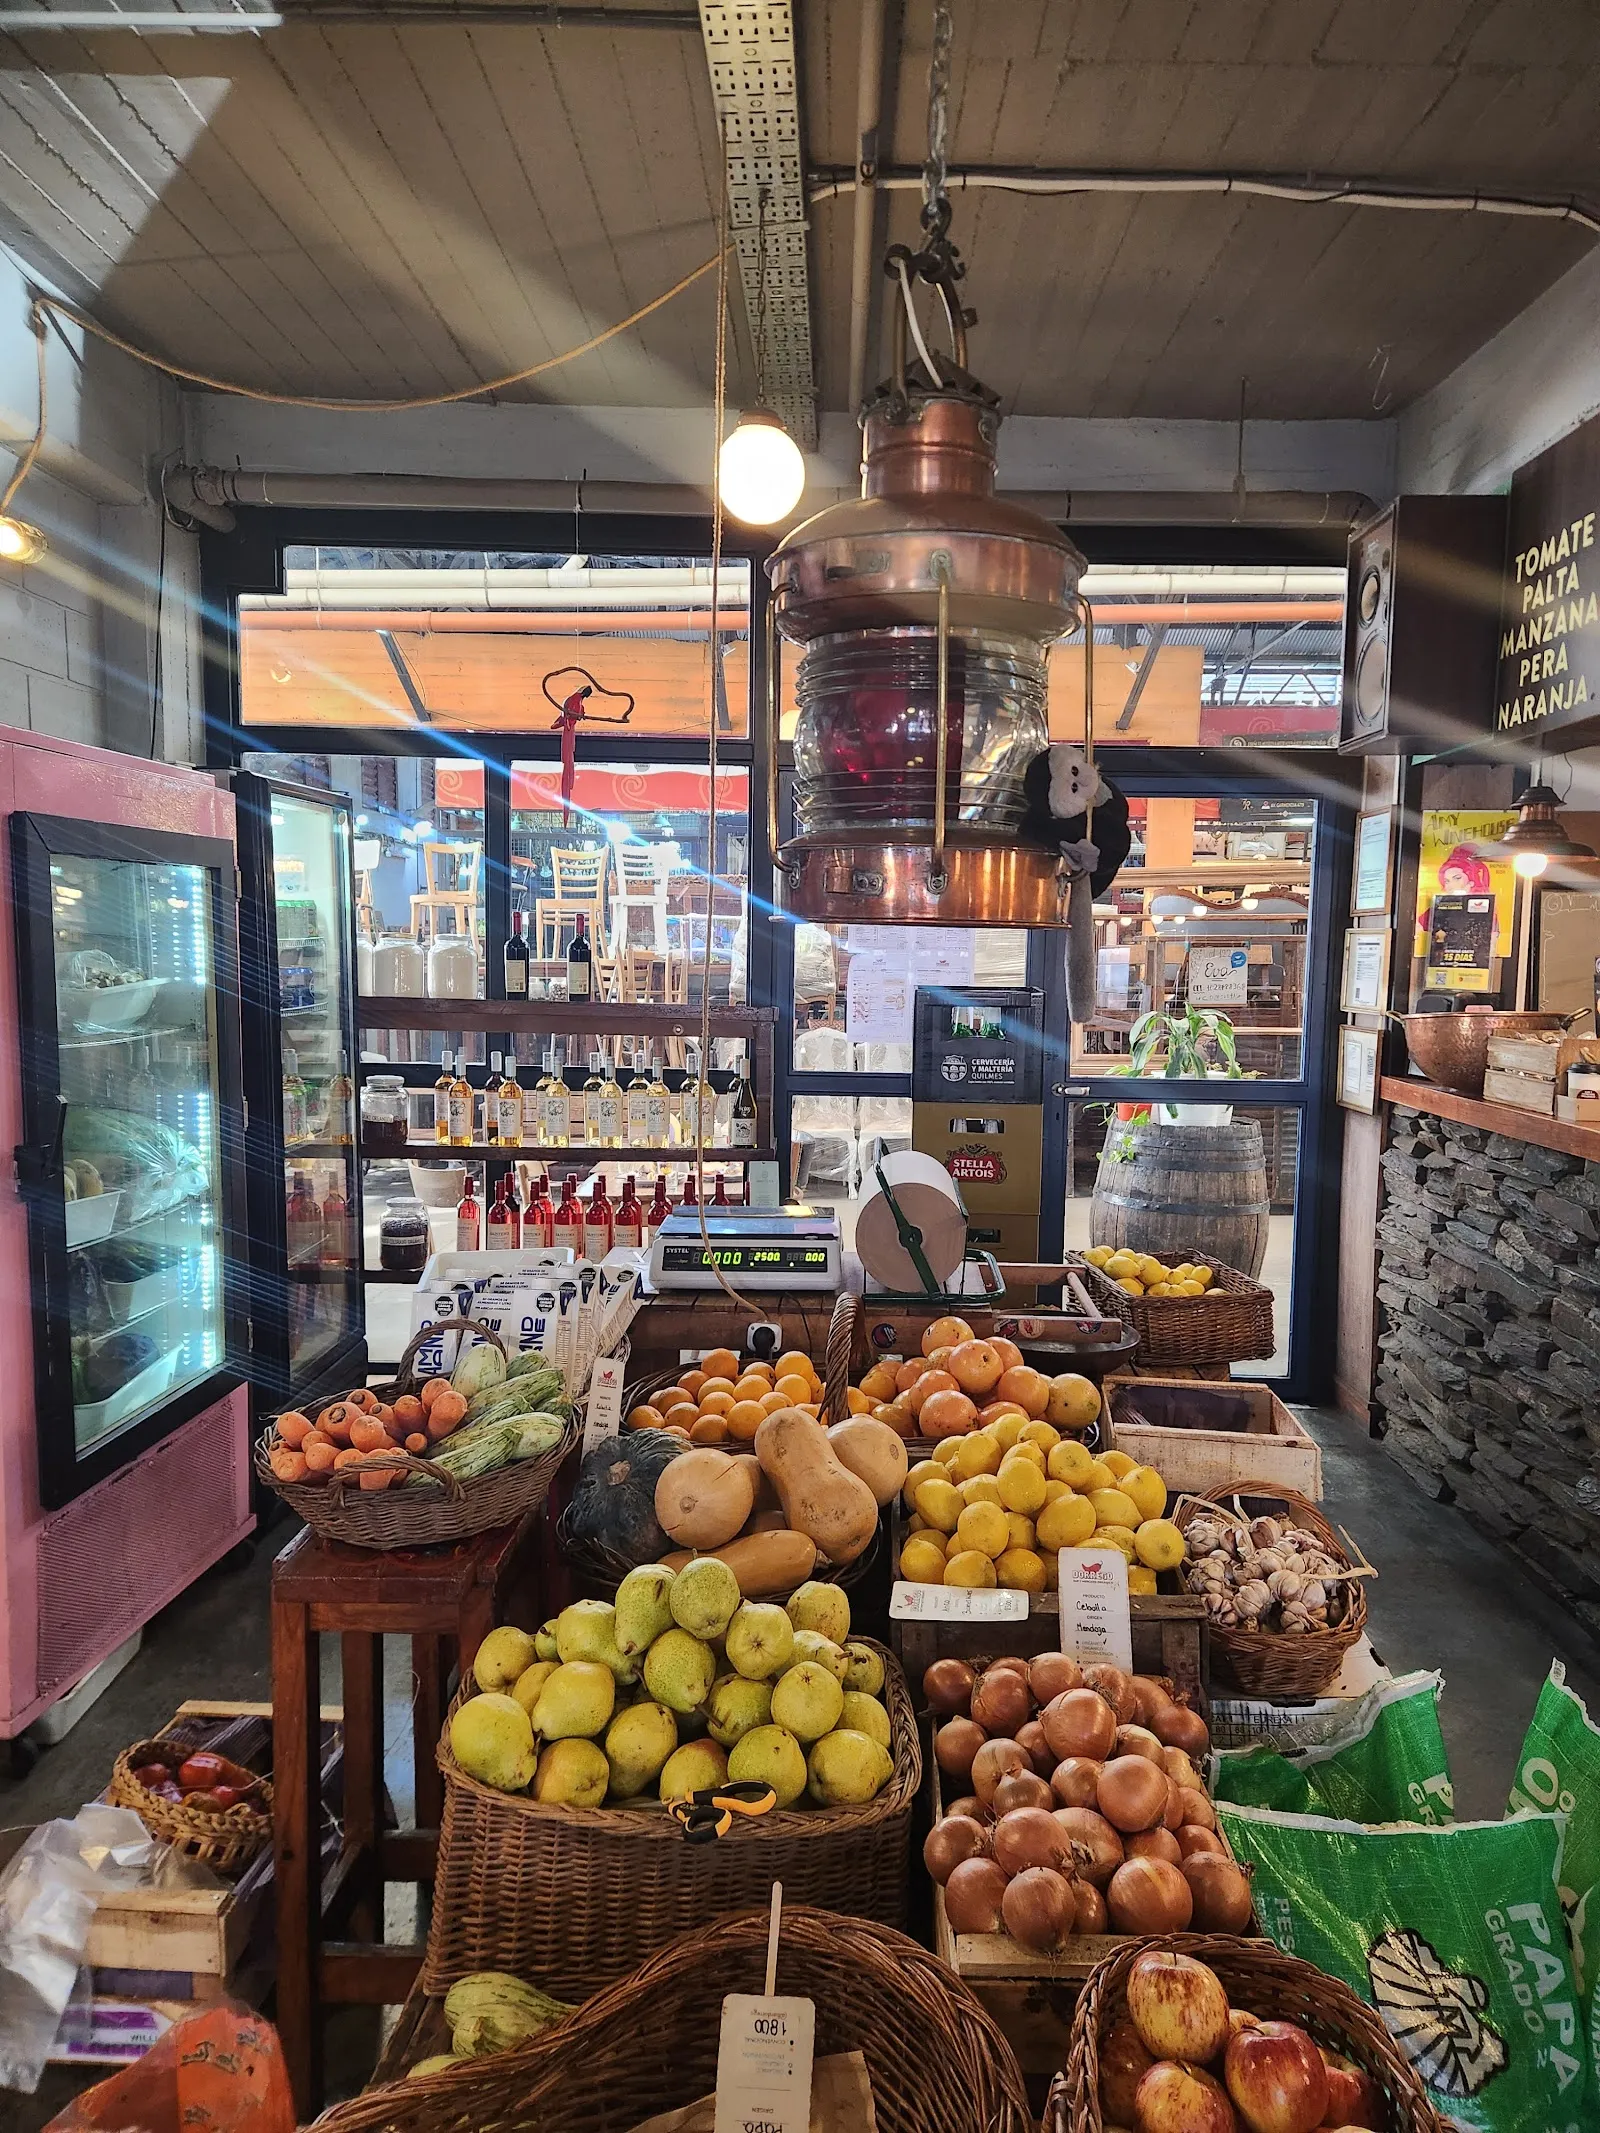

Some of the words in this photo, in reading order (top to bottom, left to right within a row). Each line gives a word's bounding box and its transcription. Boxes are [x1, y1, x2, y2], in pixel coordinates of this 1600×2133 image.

[1515, 512, 1596, 584] TOMATE
[1522, 561, 1580, 614] PALTA
[1500, 591, 1599, 660] MANZANA
[1519, 641, 1568, 687] PERA
[1497, 675, 1588, 731] NARANJA
[1433, 817, 1516, 847] WINEHOUSE
[1443, 953, 1453, 961] 15
[1204, 962, 1238, 978] Eva
[971, 1057, 1015, 1066] CERVECERÍA
[978, 1064, 1014, 1073] MALTERÍA
[971, 1072, 1003, 1080] QUILMES
[953, 1159, 993, 1168] STELLA
[952, 1168, 994, 1178] ARTOIS
[1072, 1570, 1114, 1581] DORREGO
[1076, 1622, 1107, 1636] Mendoza
[1274, 1898, 1297, 1957] PES
[1484, 1908, 1545, 2034] GRADO
[1506, 1902, 1581, 2096] PAPA
[754, 2019, 787, 2036] 1800
